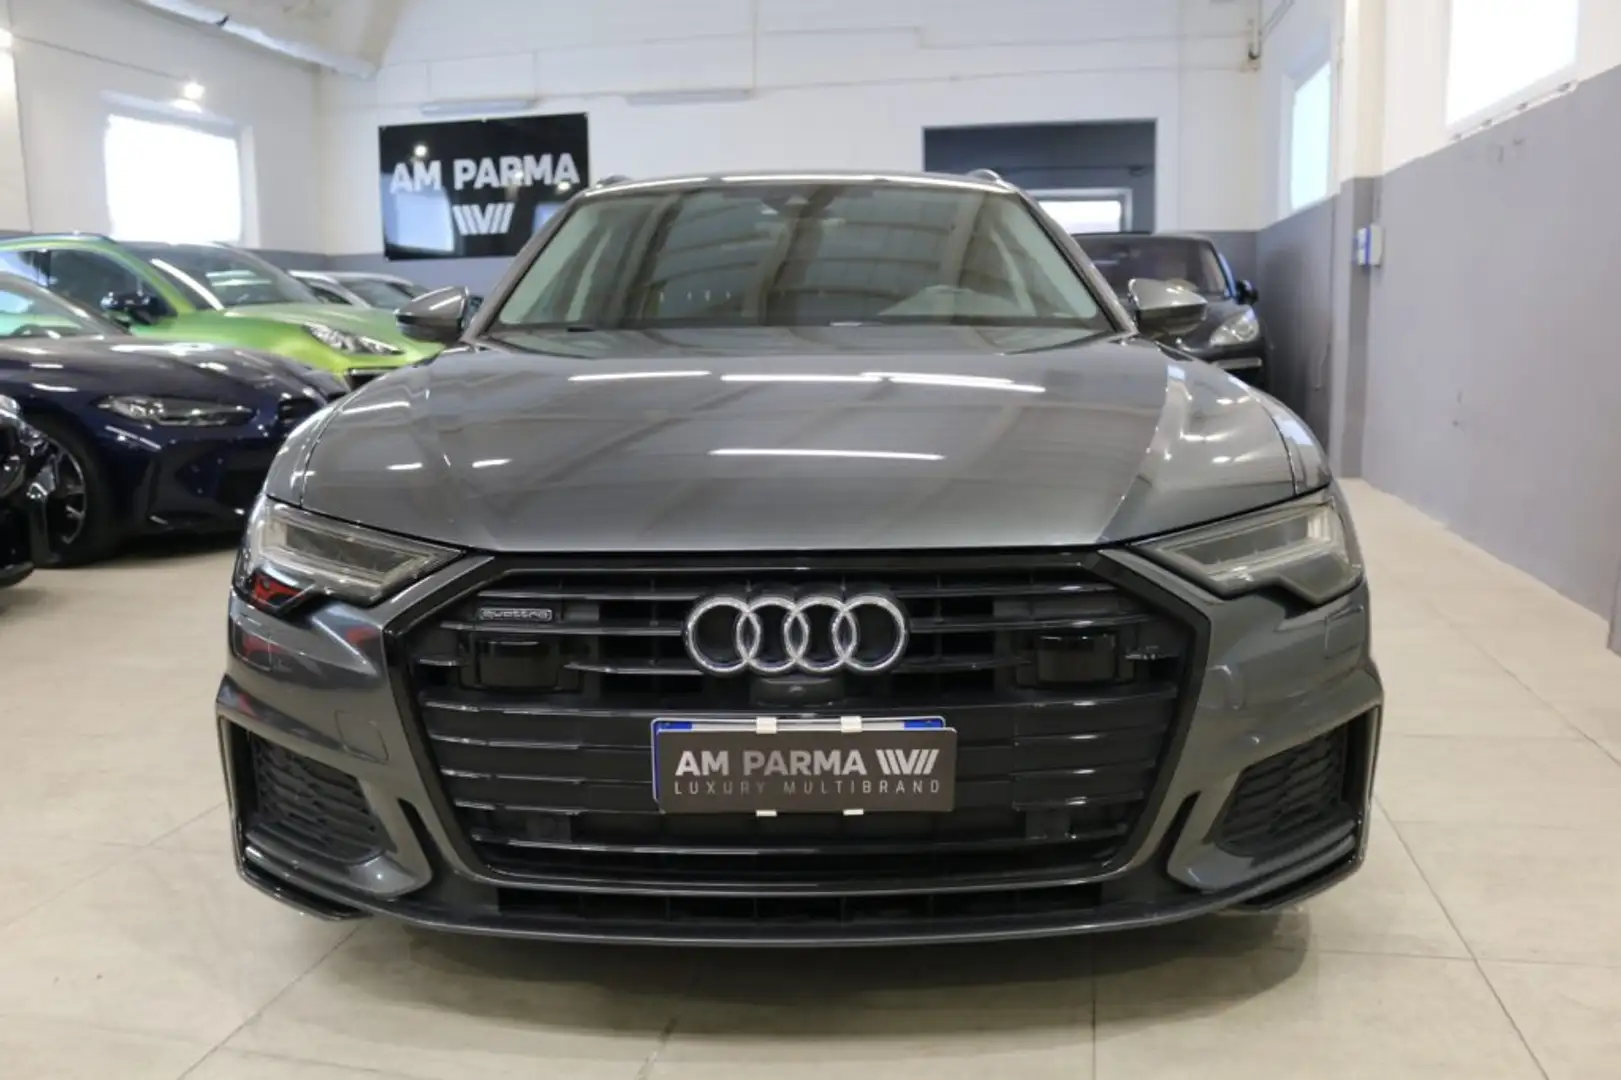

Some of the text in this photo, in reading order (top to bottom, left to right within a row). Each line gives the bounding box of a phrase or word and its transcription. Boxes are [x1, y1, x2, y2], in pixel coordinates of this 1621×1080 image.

[390, 153, 580, 194] AM PARMA
[675, 750, 867, 776] AM PARMA
[674, 779, 940, 795] LUXURY MULTIBRAND
